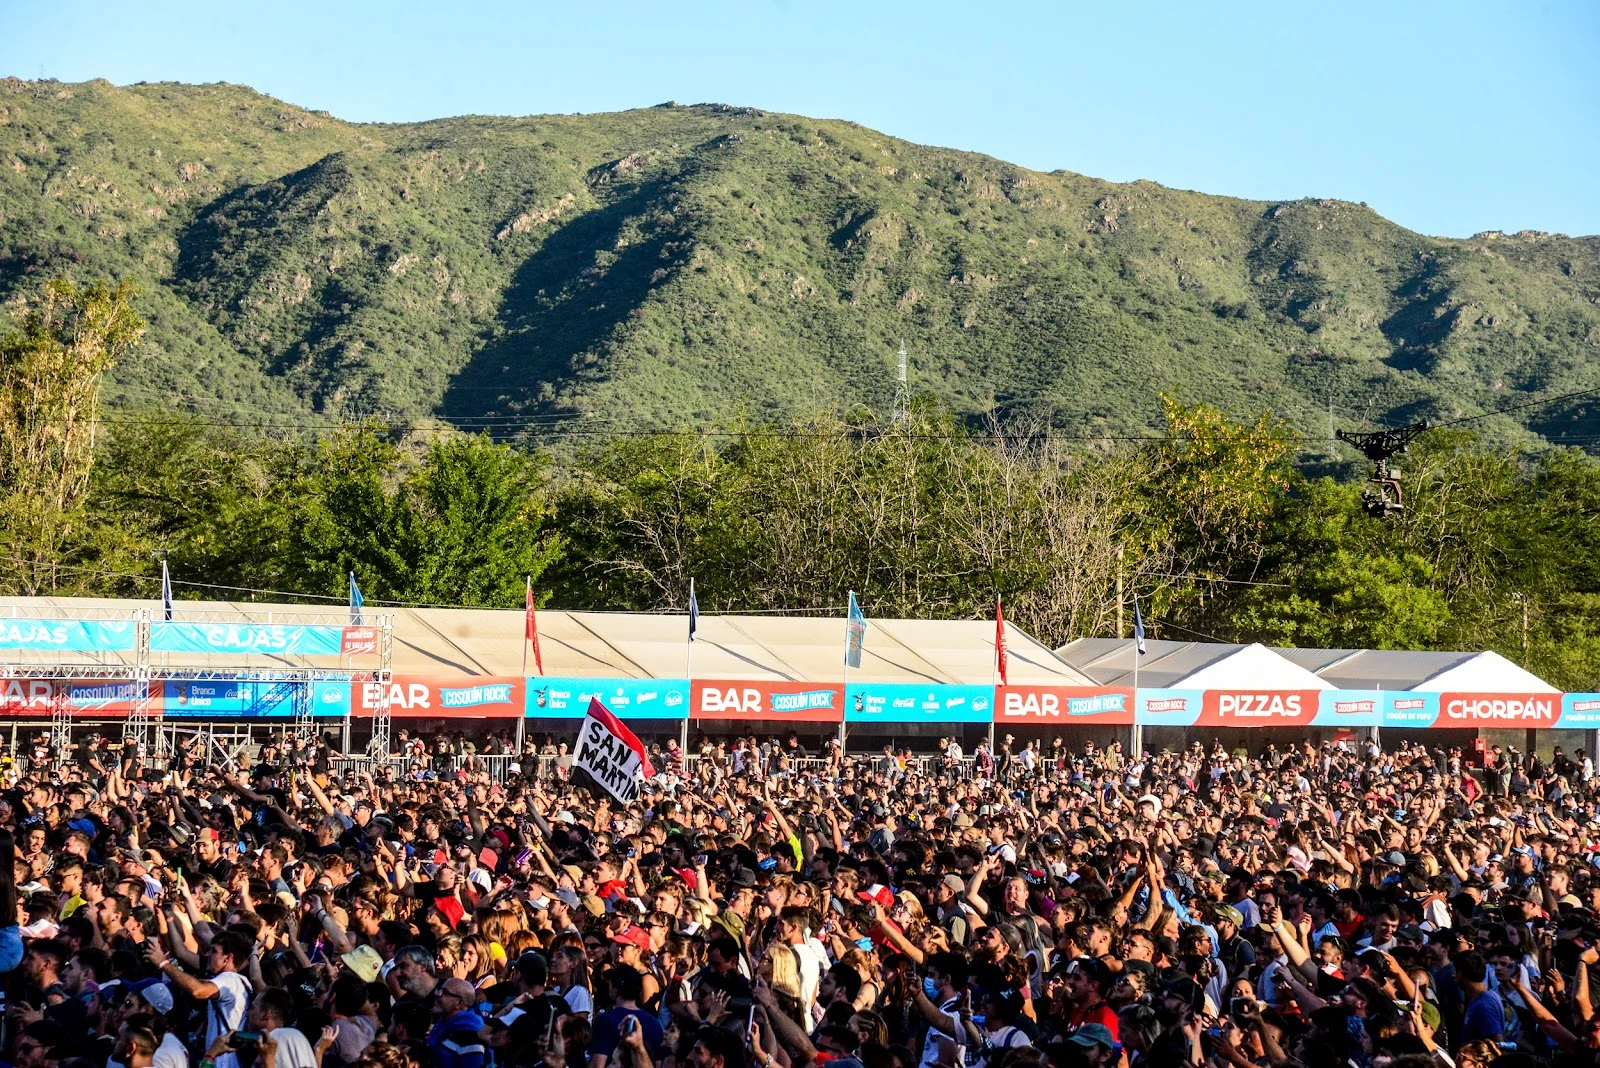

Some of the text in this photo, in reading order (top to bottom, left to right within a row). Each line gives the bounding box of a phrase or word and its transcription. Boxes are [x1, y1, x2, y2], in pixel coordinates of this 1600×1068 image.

[207, 627, 286, 648] CAJAS
[0, 680, 54, 707] AR
[192, 686, 216, 696] Branca
[362, 684, 431, 709] BAR
[446, 686, 508, 705] COSQUÍN ROCK
[701, 687, 762, 712] BAR
[775, 692, 830, 710] COSQUÍN ROCK
[1004, 693, 1059, 716] BAR
[1072, 695, 1123, 713] COSQUÍN ROCK
[1219, 695, 1301, 717] PIZZAS
[1447, 697, 1552, 720] CHORIPÁN
[588, 721, 632, 766] SAN
